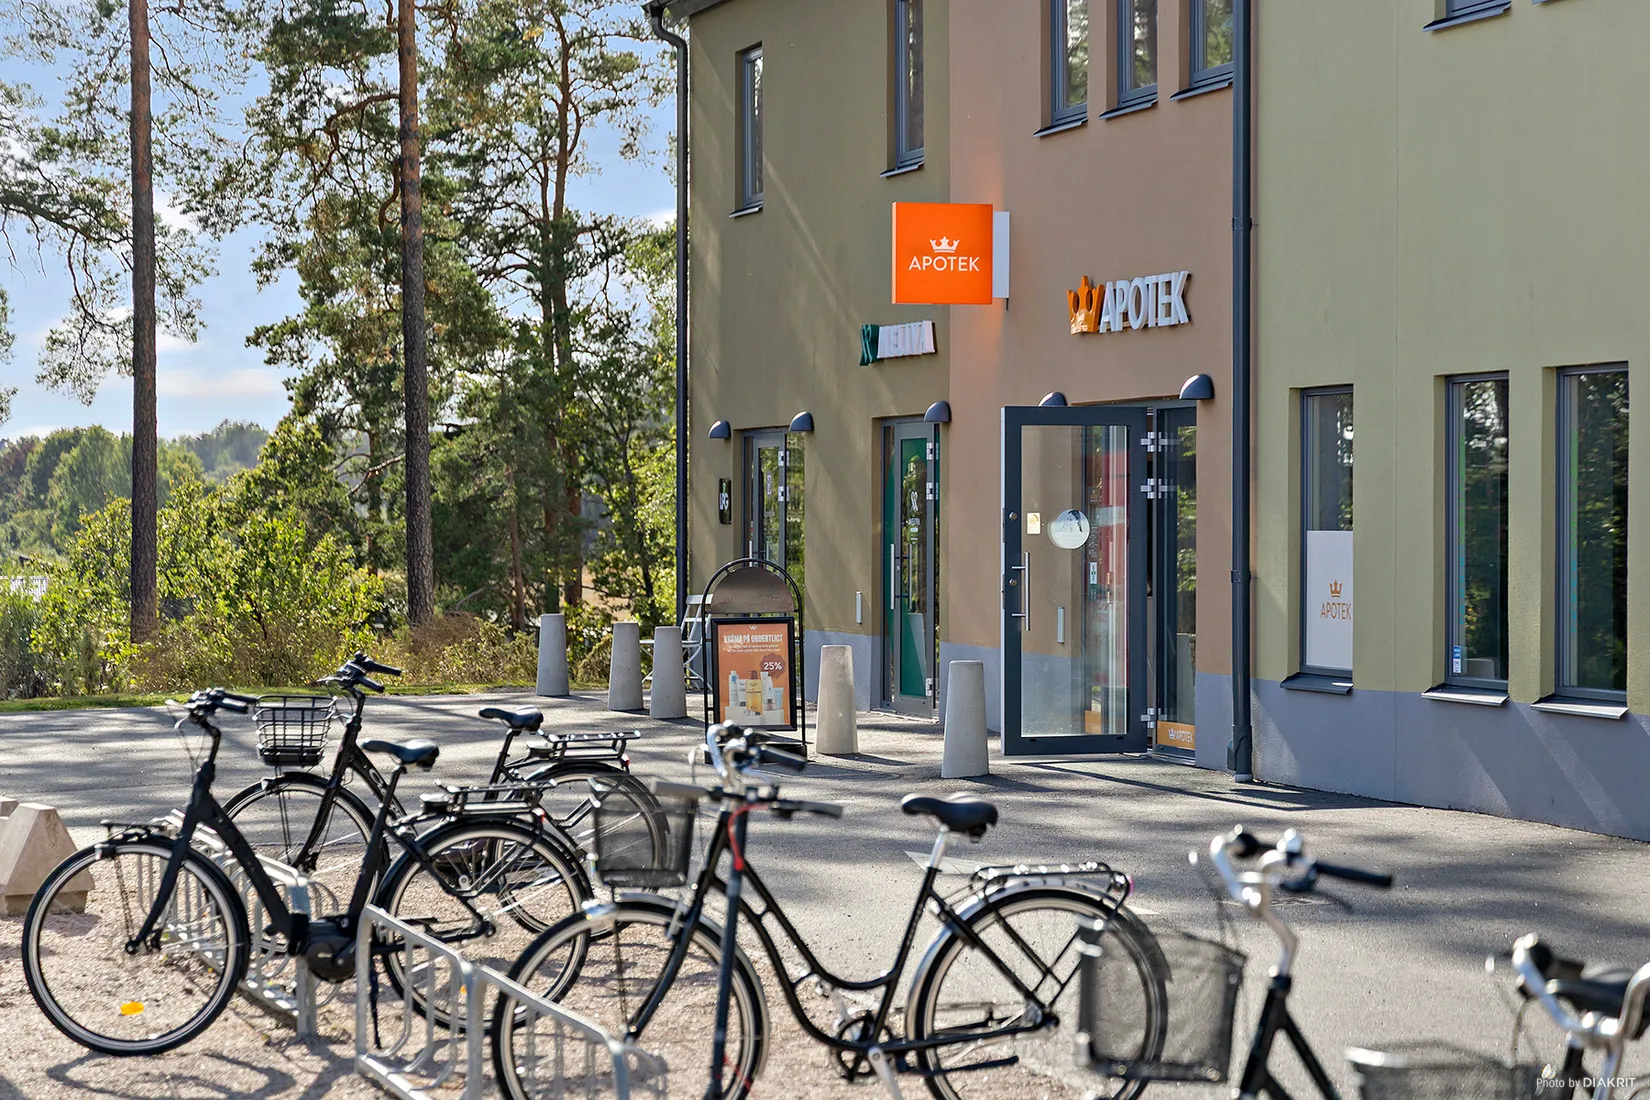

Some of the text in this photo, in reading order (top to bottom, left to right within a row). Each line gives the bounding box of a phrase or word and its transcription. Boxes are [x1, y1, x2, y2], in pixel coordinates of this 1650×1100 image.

[908, 256, 980, 272] APOTEK
[1099, 270, 1189, 334] APOTEK
[1320, 602, 1352, 620] APOTEK
[763, 661, 782, 670] 25%
